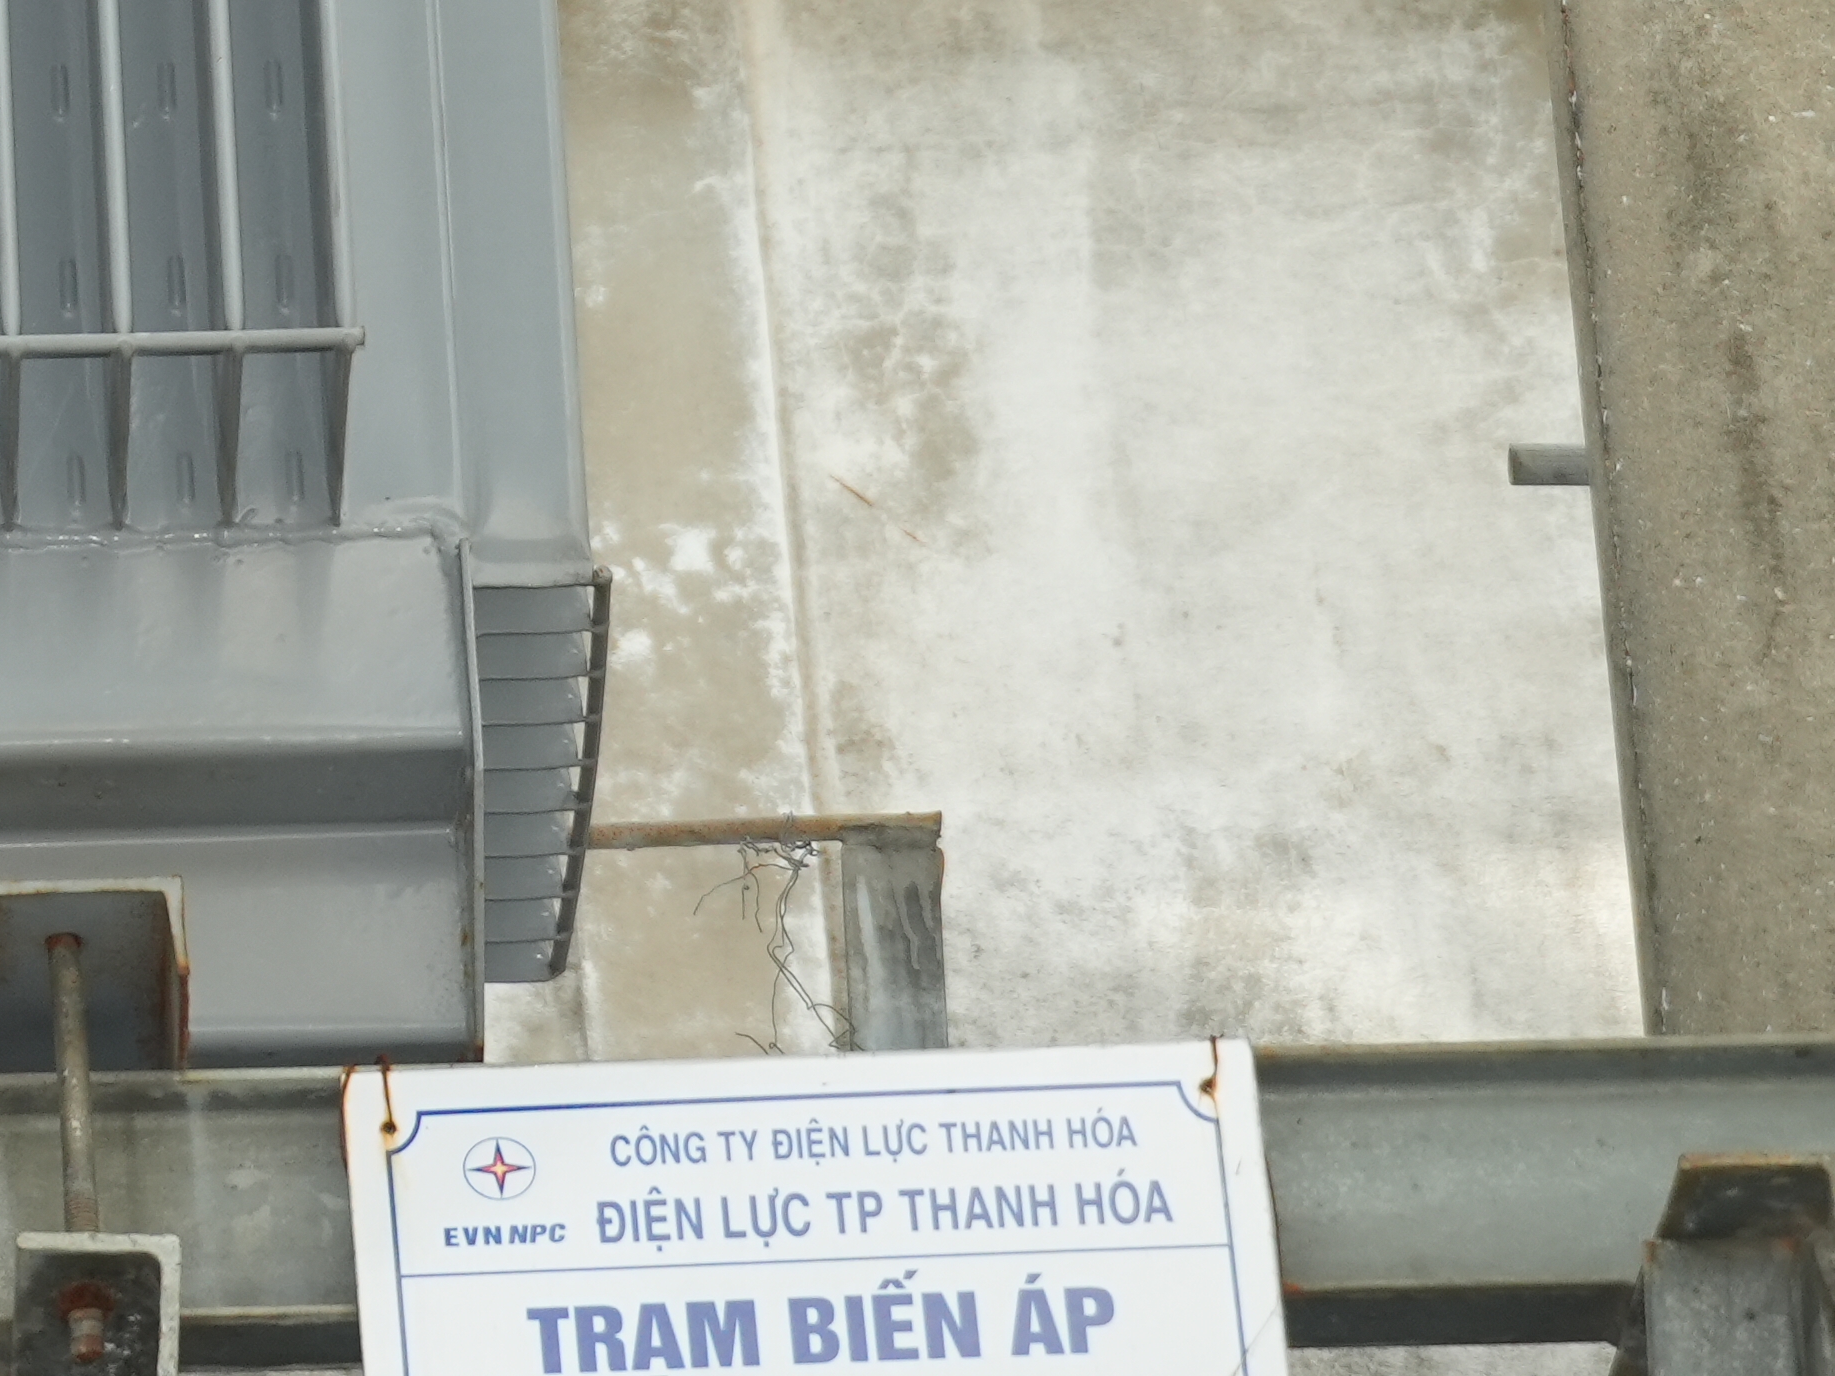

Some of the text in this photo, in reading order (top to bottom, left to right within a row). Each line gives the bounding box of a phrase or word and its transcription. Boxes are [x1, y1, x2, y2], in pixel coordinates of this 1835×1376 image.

[609, 1106, 1139, 1167] CÔNG TY ĐIỆN LỰC THANH HÓA
[596, 1167, 1174, 1252] ĐIỆN LỰC TP THANH HÓA
[786, 1268, 982, 1365] BIẾN
[1010, 1272, 1116, 1356] ÁP
